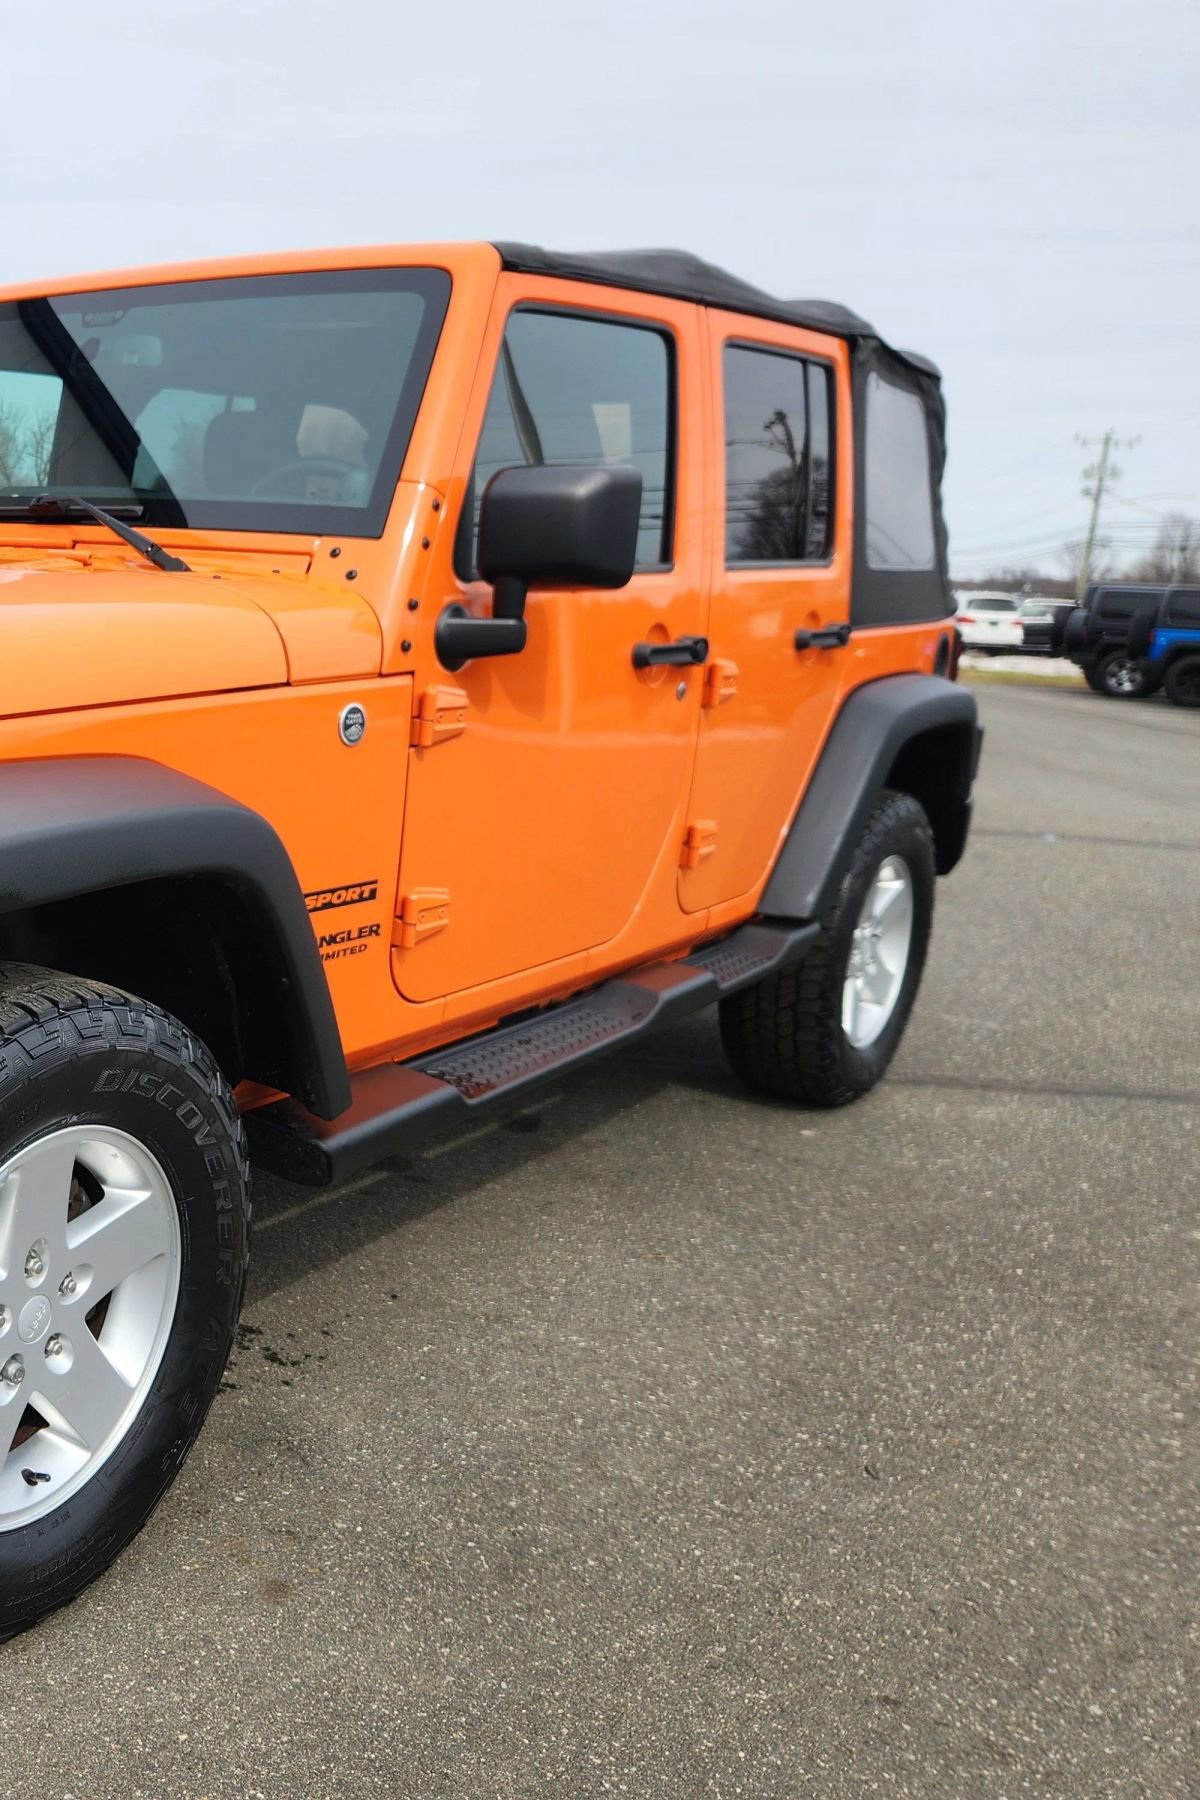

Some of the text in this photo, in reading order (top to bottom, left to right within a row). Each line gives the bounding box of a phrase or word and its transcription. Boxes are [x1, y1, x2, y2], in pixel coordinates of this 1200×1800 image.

[304, 884, 377, 910] SPORT
[318, 924, 380, 948] NGLER
[321, 944, 367, 961] IMITED
